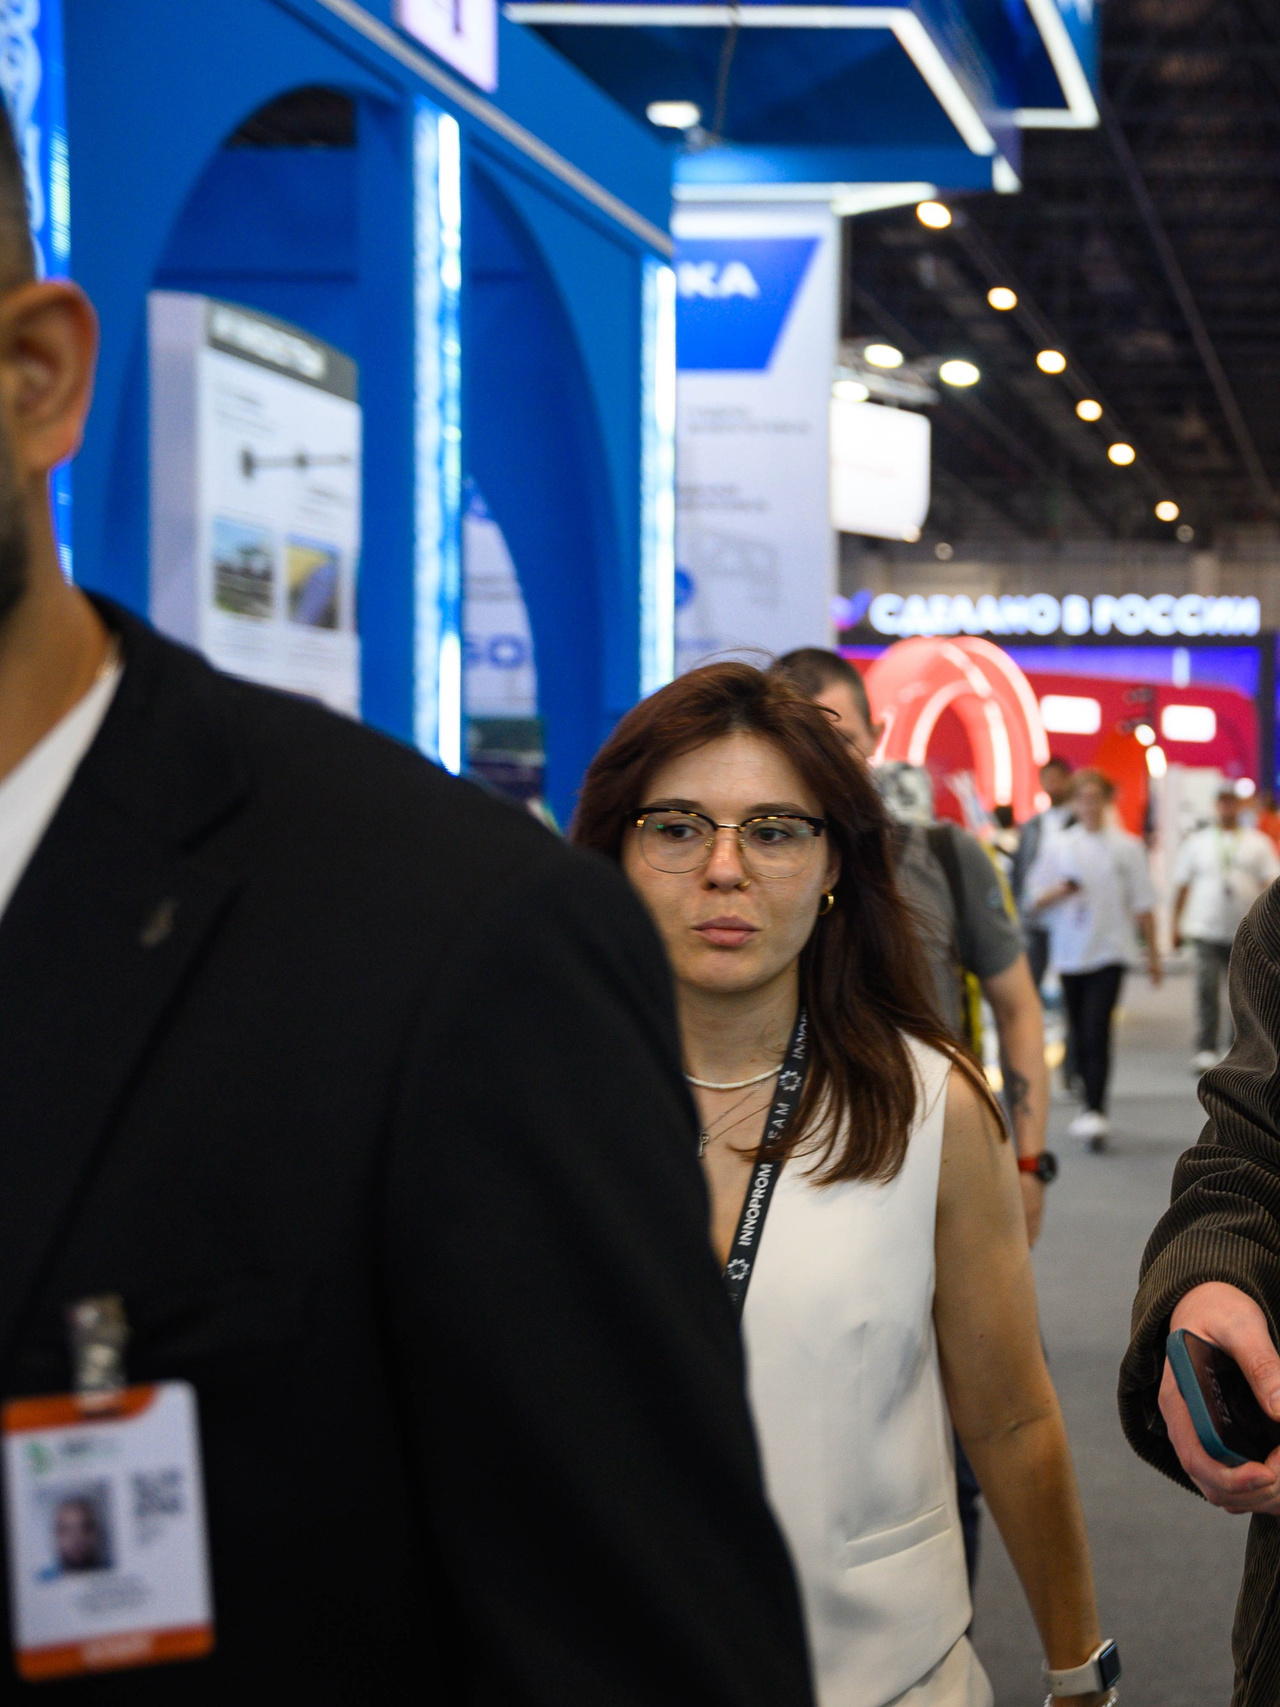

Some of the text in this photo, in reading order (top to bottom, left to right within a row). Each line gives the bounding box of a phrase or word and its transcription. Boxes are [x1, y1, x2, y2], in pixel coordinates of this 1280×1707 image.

[869, 593, 1061, 637] СДЕЛАНО
[1062, 594, 1091, 636] В
[1092, 593, 1261, 636] РОССИИ
[765, 1101, 791, 1149] EAM
[738, 1163, 773, 1247] INNOPROM
